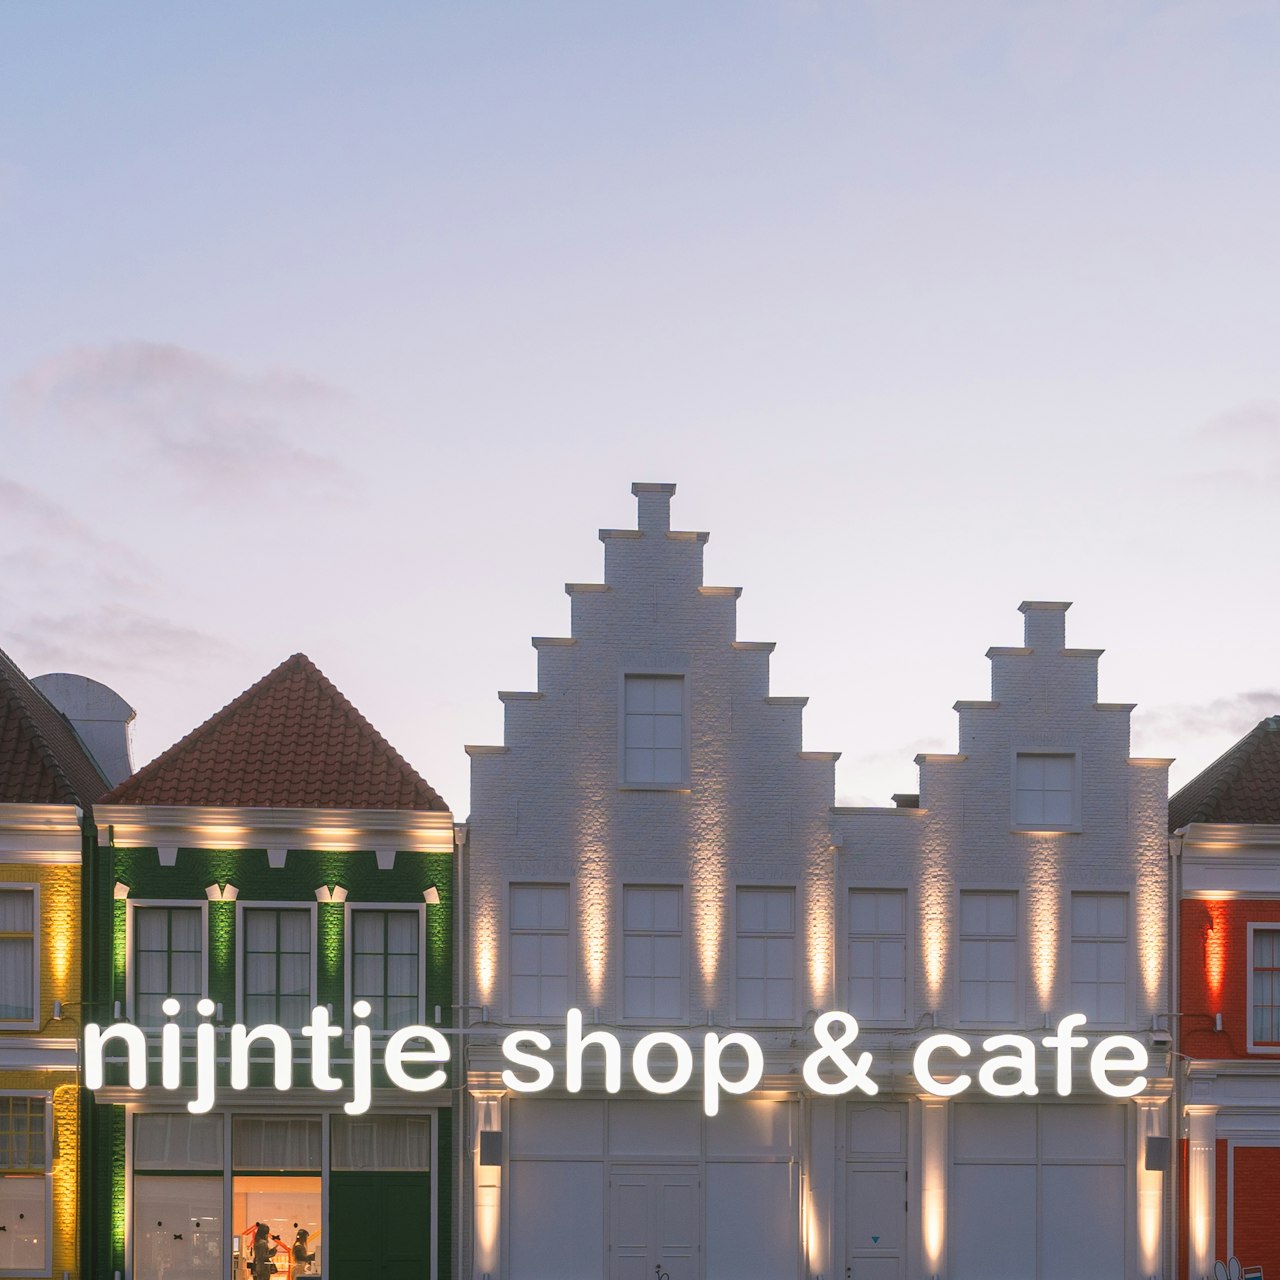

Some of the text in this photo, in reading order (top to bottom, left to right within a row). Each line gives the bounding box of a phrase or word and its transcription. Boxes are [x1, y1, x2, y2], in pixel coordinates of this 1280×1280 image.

[83, 998, 1149, 1117] nijntje shop & cafe
